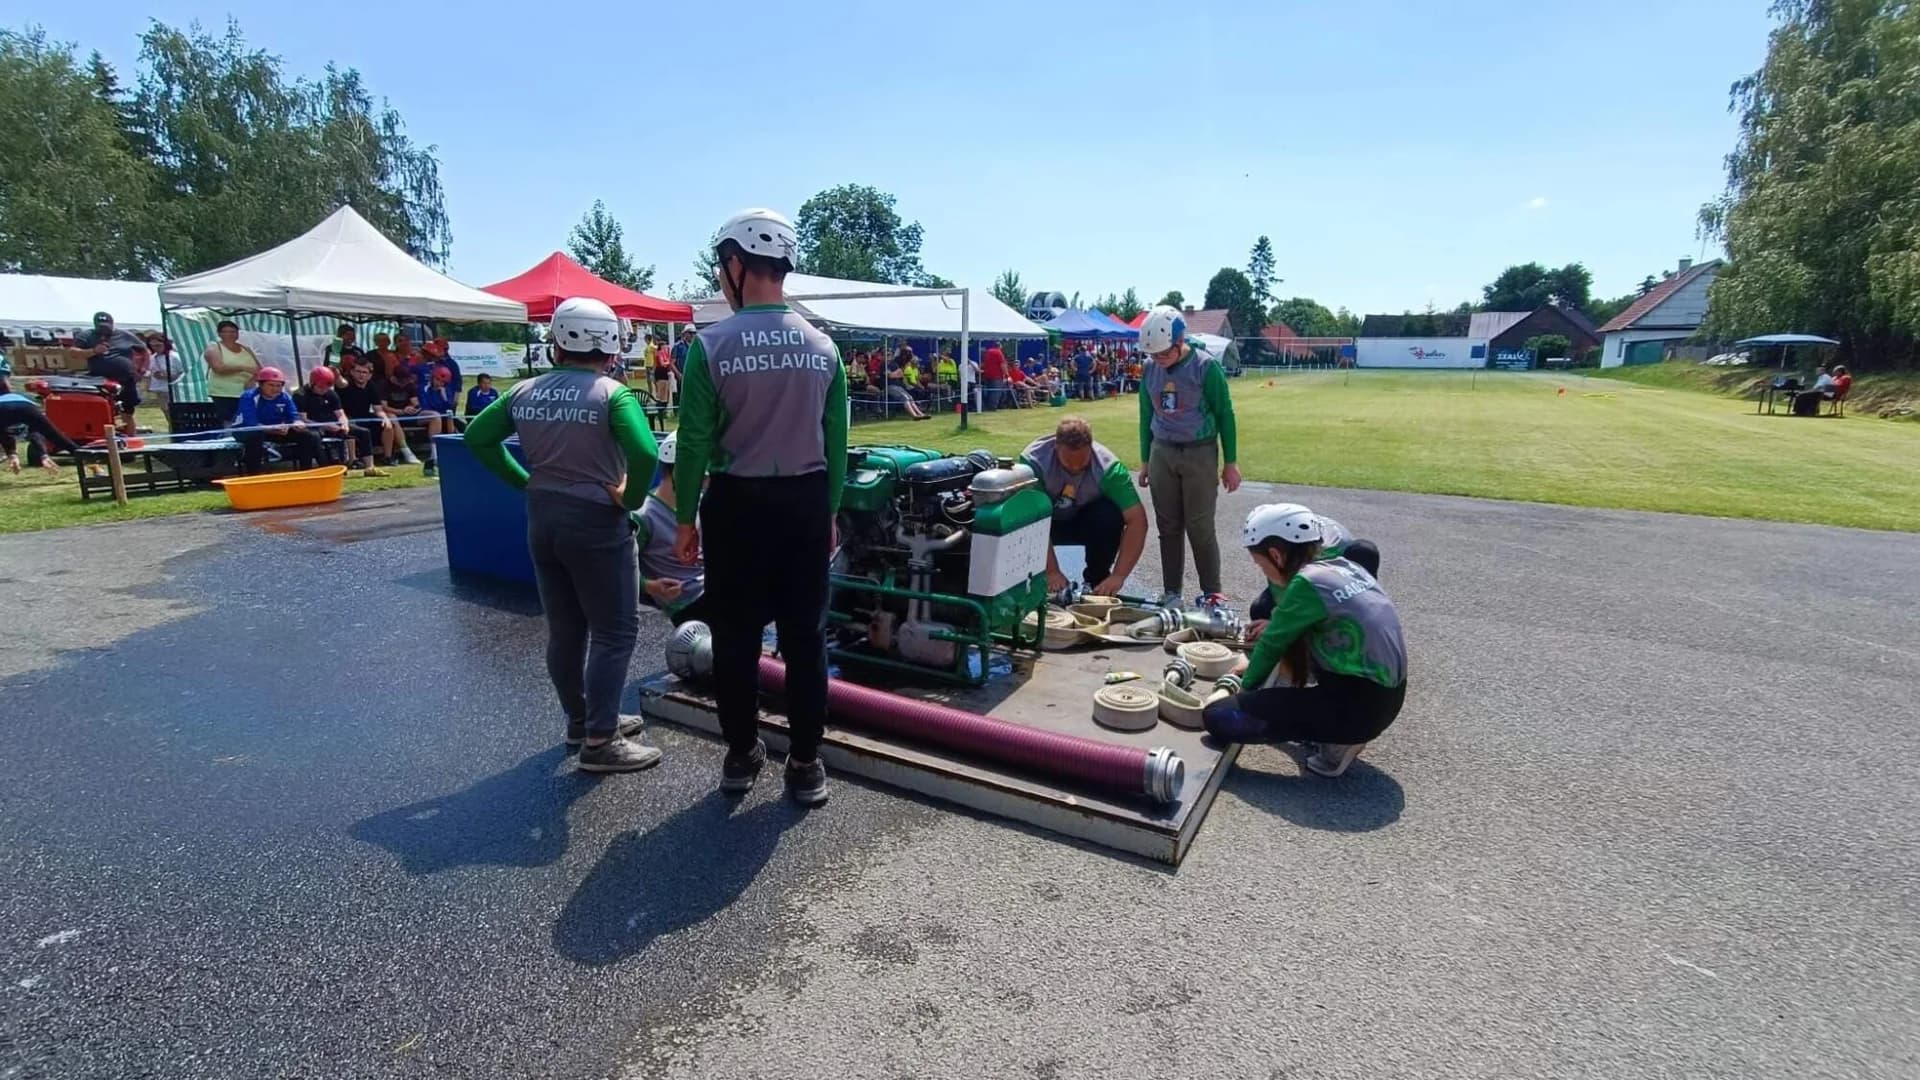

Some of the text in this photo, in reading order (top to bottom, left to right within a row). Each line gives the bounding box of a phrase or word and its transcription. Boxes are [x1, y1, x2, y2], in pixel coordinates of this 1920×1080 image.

[741, 327, 805, 348] HASIČI
[719, 353, 828, 377] RADSLAVICE
[530, 386, 581, 401] HASIČI
[511, 406, 599, 425] RADSLAVICE
